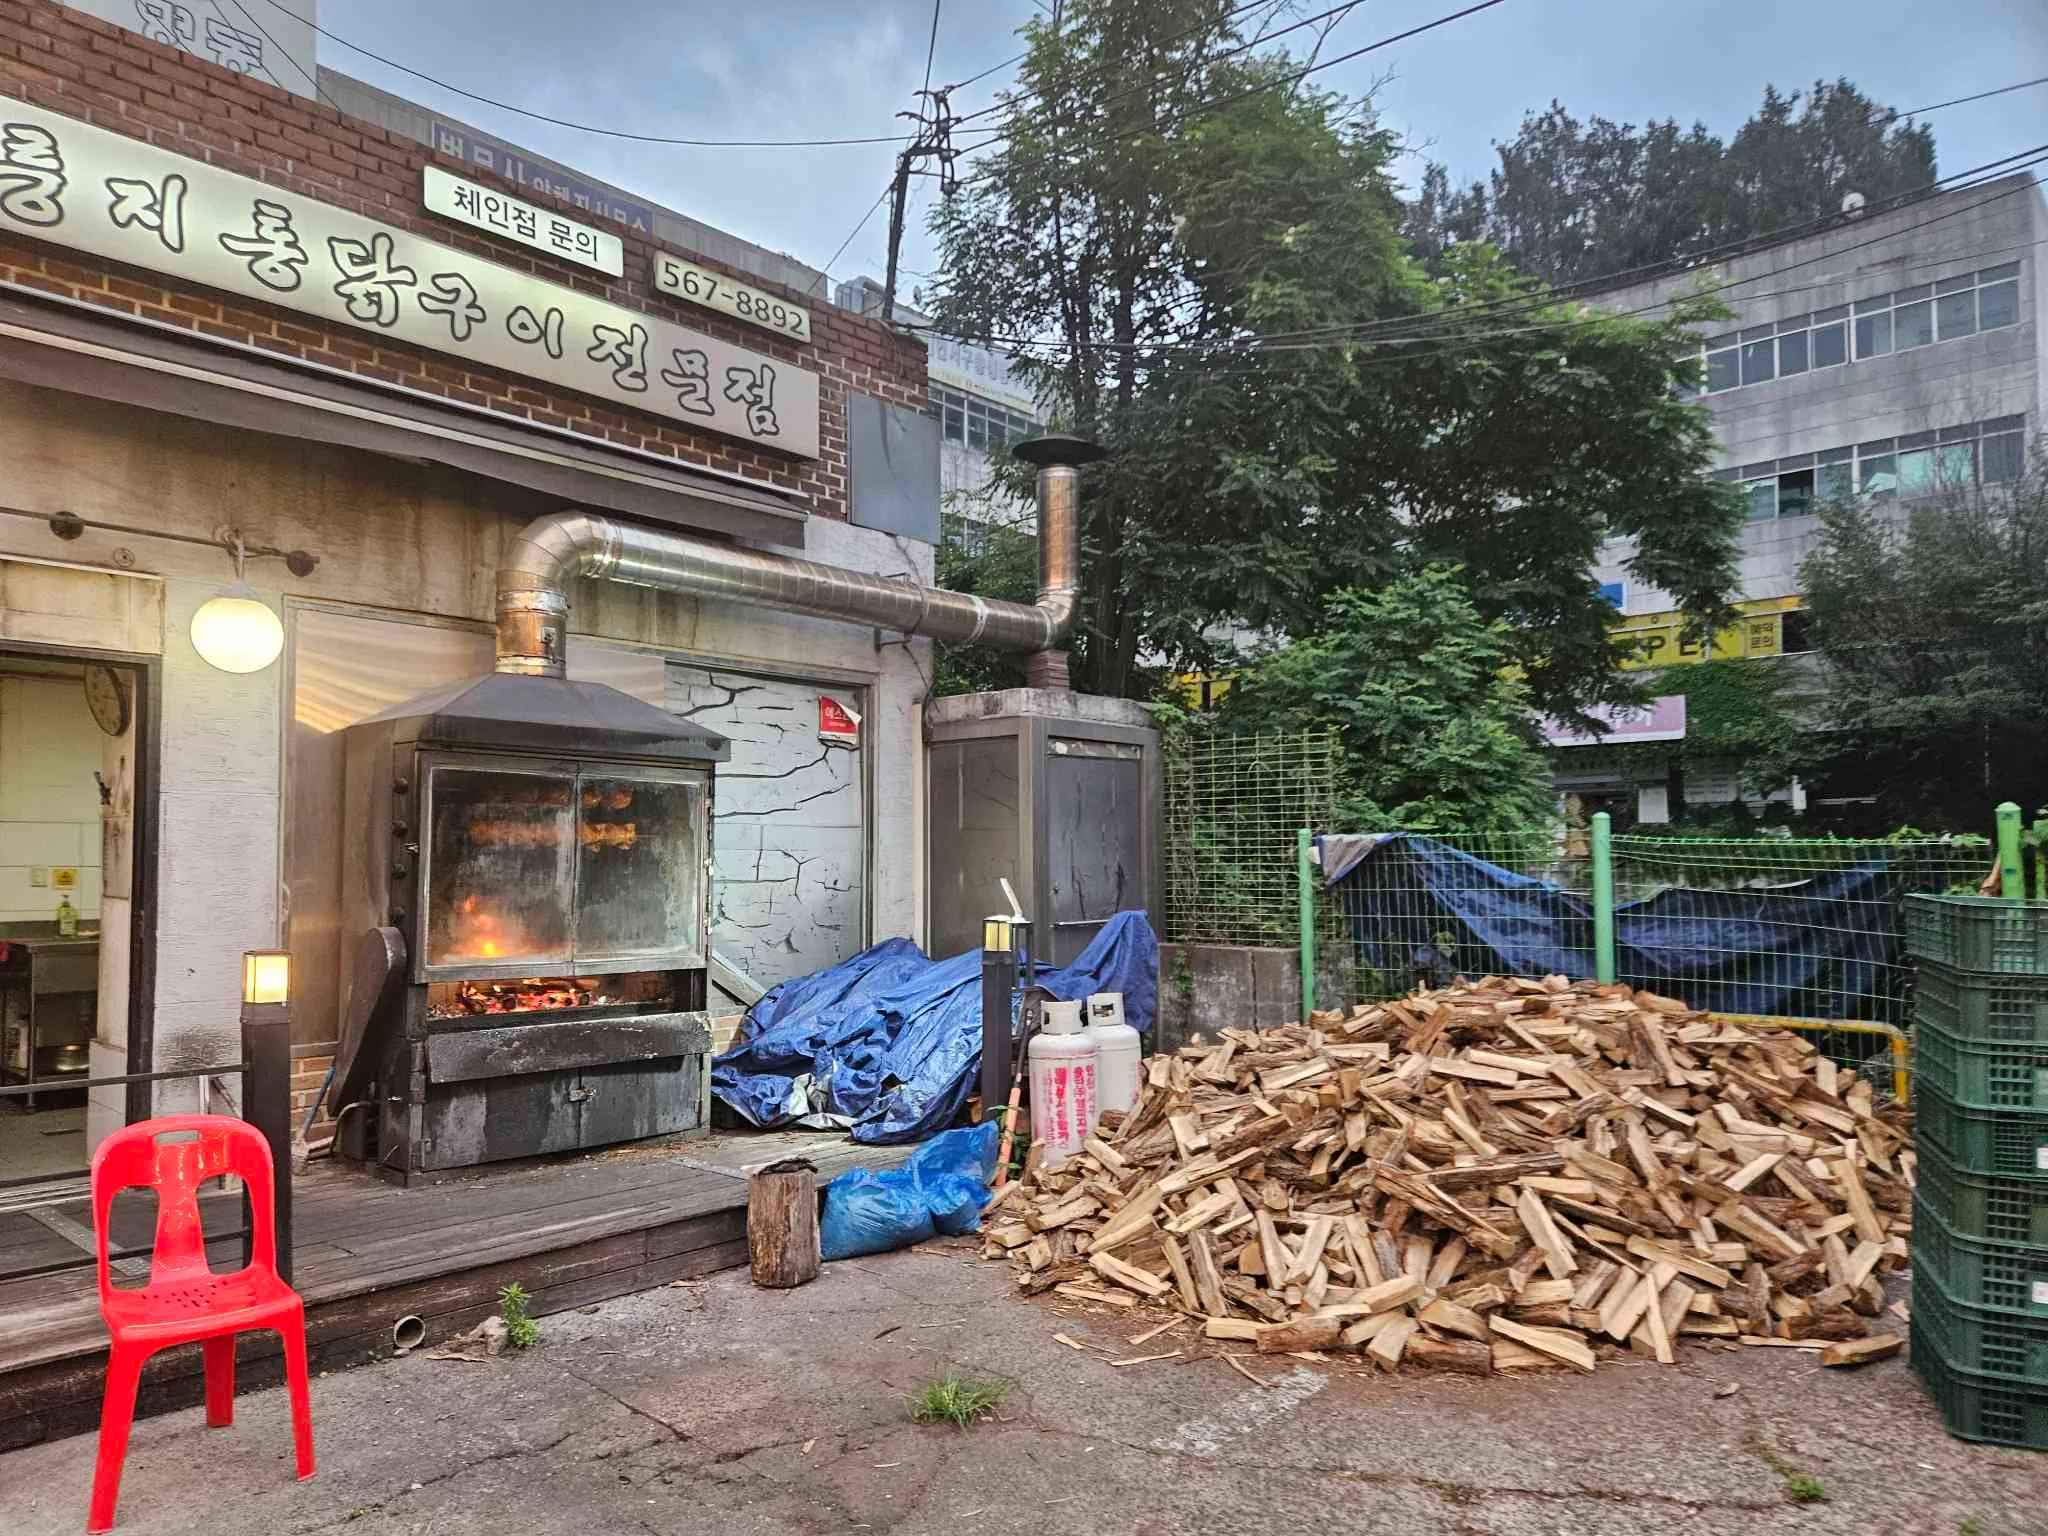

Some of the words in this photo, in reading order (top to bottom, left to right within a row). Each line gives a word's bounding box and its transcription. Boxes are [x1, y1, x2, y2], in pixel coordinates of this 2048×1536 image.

[453, 185, 537, 240] 체인점
[548, 218, 599, 262] 문의
[661, 260, 805, 336] 567-8892
